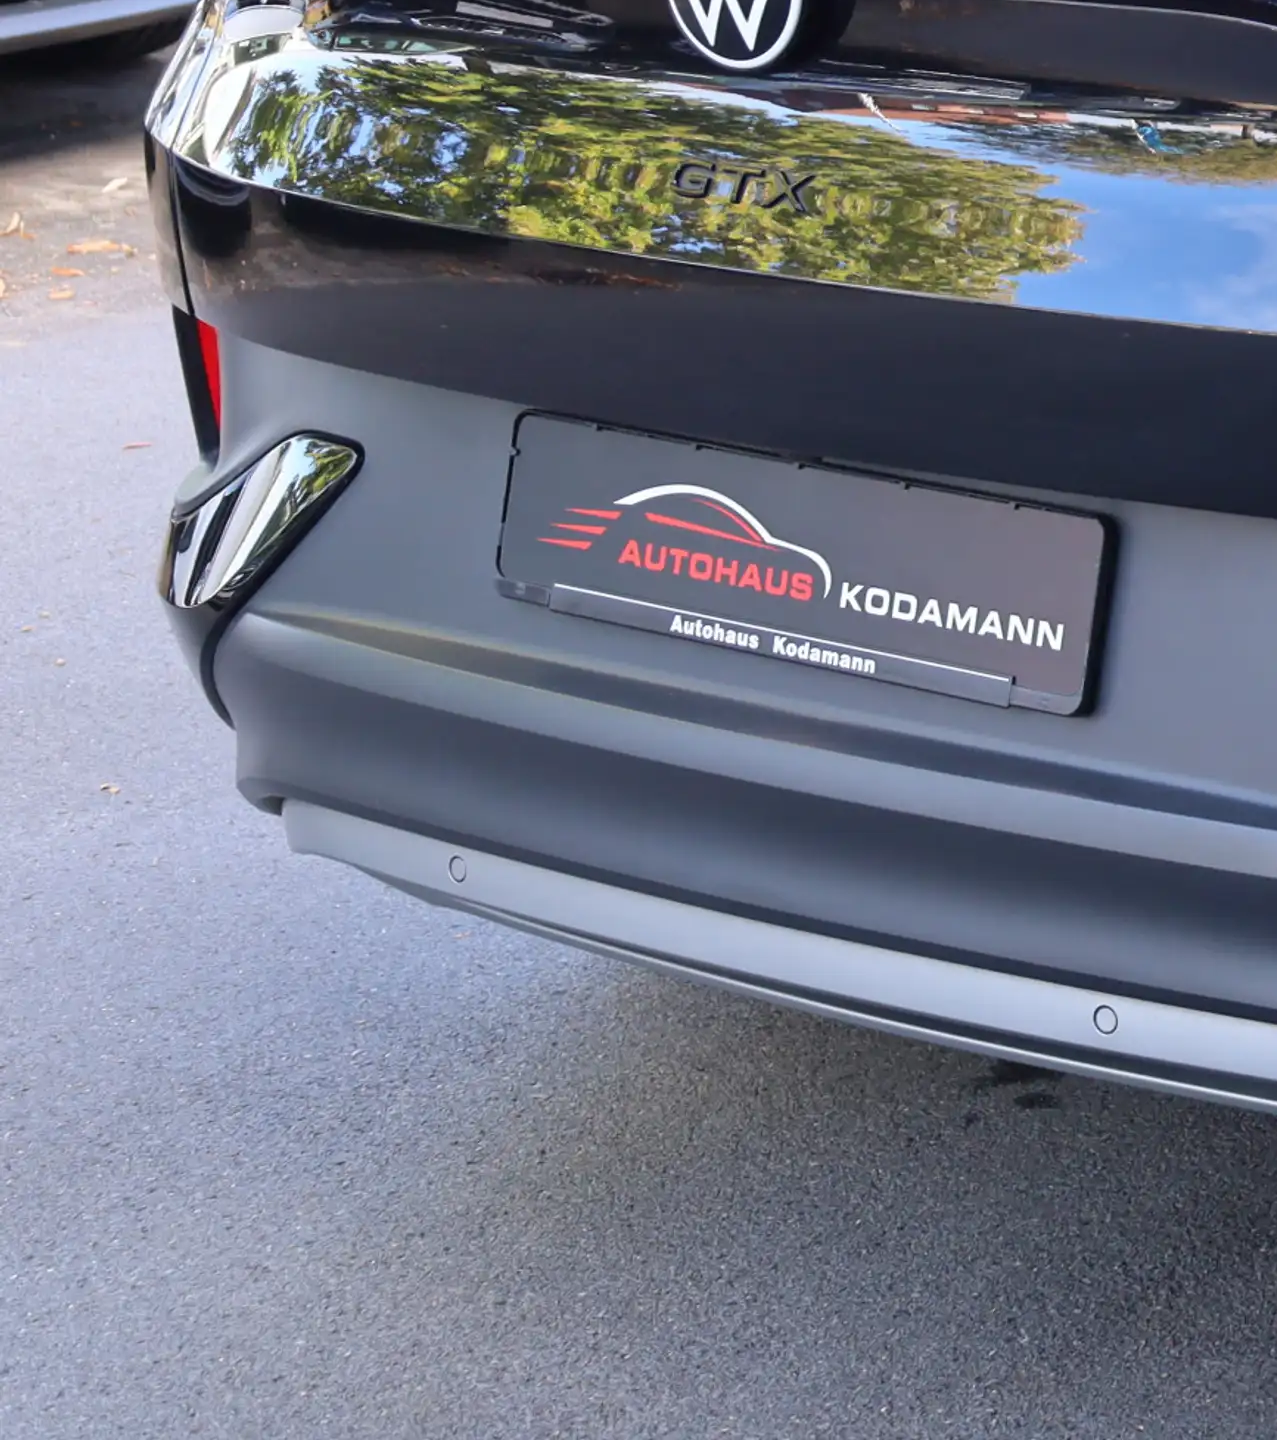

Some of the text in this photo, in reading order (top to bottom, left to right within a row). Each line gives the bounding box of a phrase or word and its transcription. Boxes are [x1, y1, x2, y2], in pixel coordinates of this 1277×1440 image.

[672, 161, 816, 213] GTX
[618, 539, 1066, 651] AUTOHAUS KODAMANN
[669, 615, 876, 675] Autohaus Kodamann
